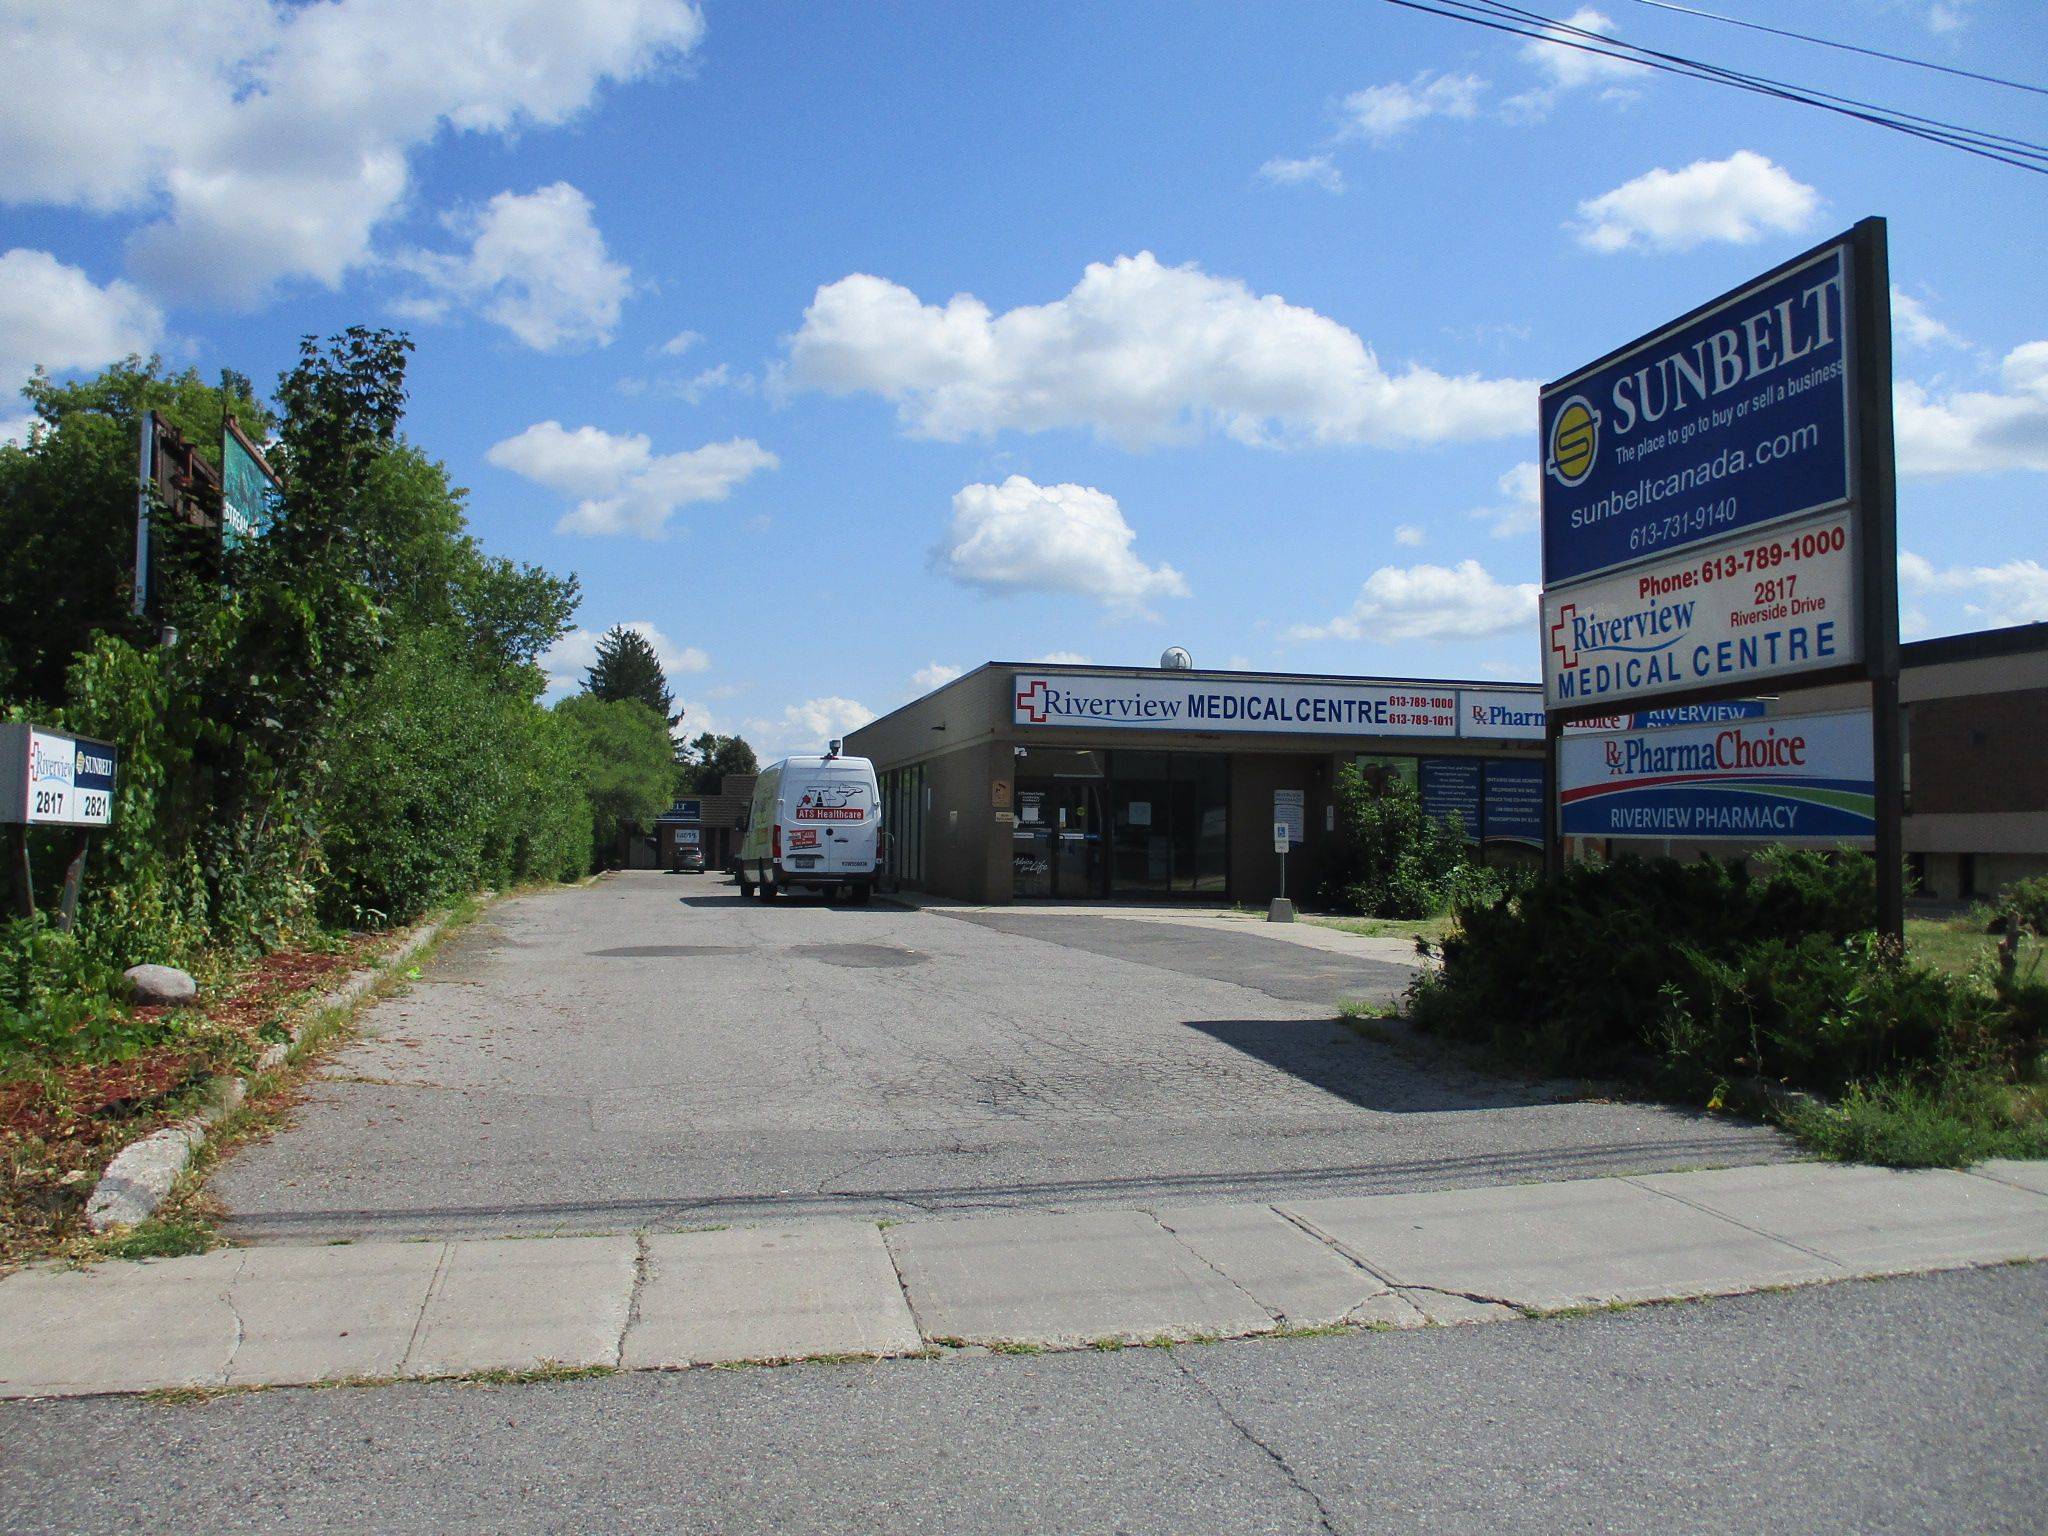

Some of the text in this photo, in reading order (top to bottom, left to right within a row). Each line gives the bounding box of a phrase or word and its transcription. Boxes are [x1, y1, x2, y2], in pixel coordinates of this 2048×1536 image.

[1612, 277, 1841, 435] SUNBELT
[1615, 358, 1844, 465] The place to go to buy or sell a business
[1571, 423, 1818, 528] sunbeltcanada.com
[1629, 497, 1736, 550] 613-731-9140
[1639, 526, 1845, 600] Phone: 613-789-1000
[1754, 575, 1797, 605] 2817
[1572, 599, 1696, 652] Riverview
[1730, 596, 1826, 629] Riverside Drive
[1558, 621, 1835, 700] MEDICAL CENTRE
[1042, 690, 1388, 724] Riverview MEDICAL CENTRE
[1389, 695, 1454, 709] 613-789-1000
[1649, 704, 1747, 722] RIVERVIEW
[1389, 713, 1454, 726] 613-789-1011
[37, 750, 74, 778] Riverview
[85, 755, 112, 777] SUNBELT
[1625, 727, 1806, 775] PharmaChoice
[36, 790, 63, 815] 2817
[85, 796, 107, 817] 2821
[799, 809, 862, 819] ATS Healthcare
[1611, 805, 1798, 829] RIVERVIEW PHARMACY
